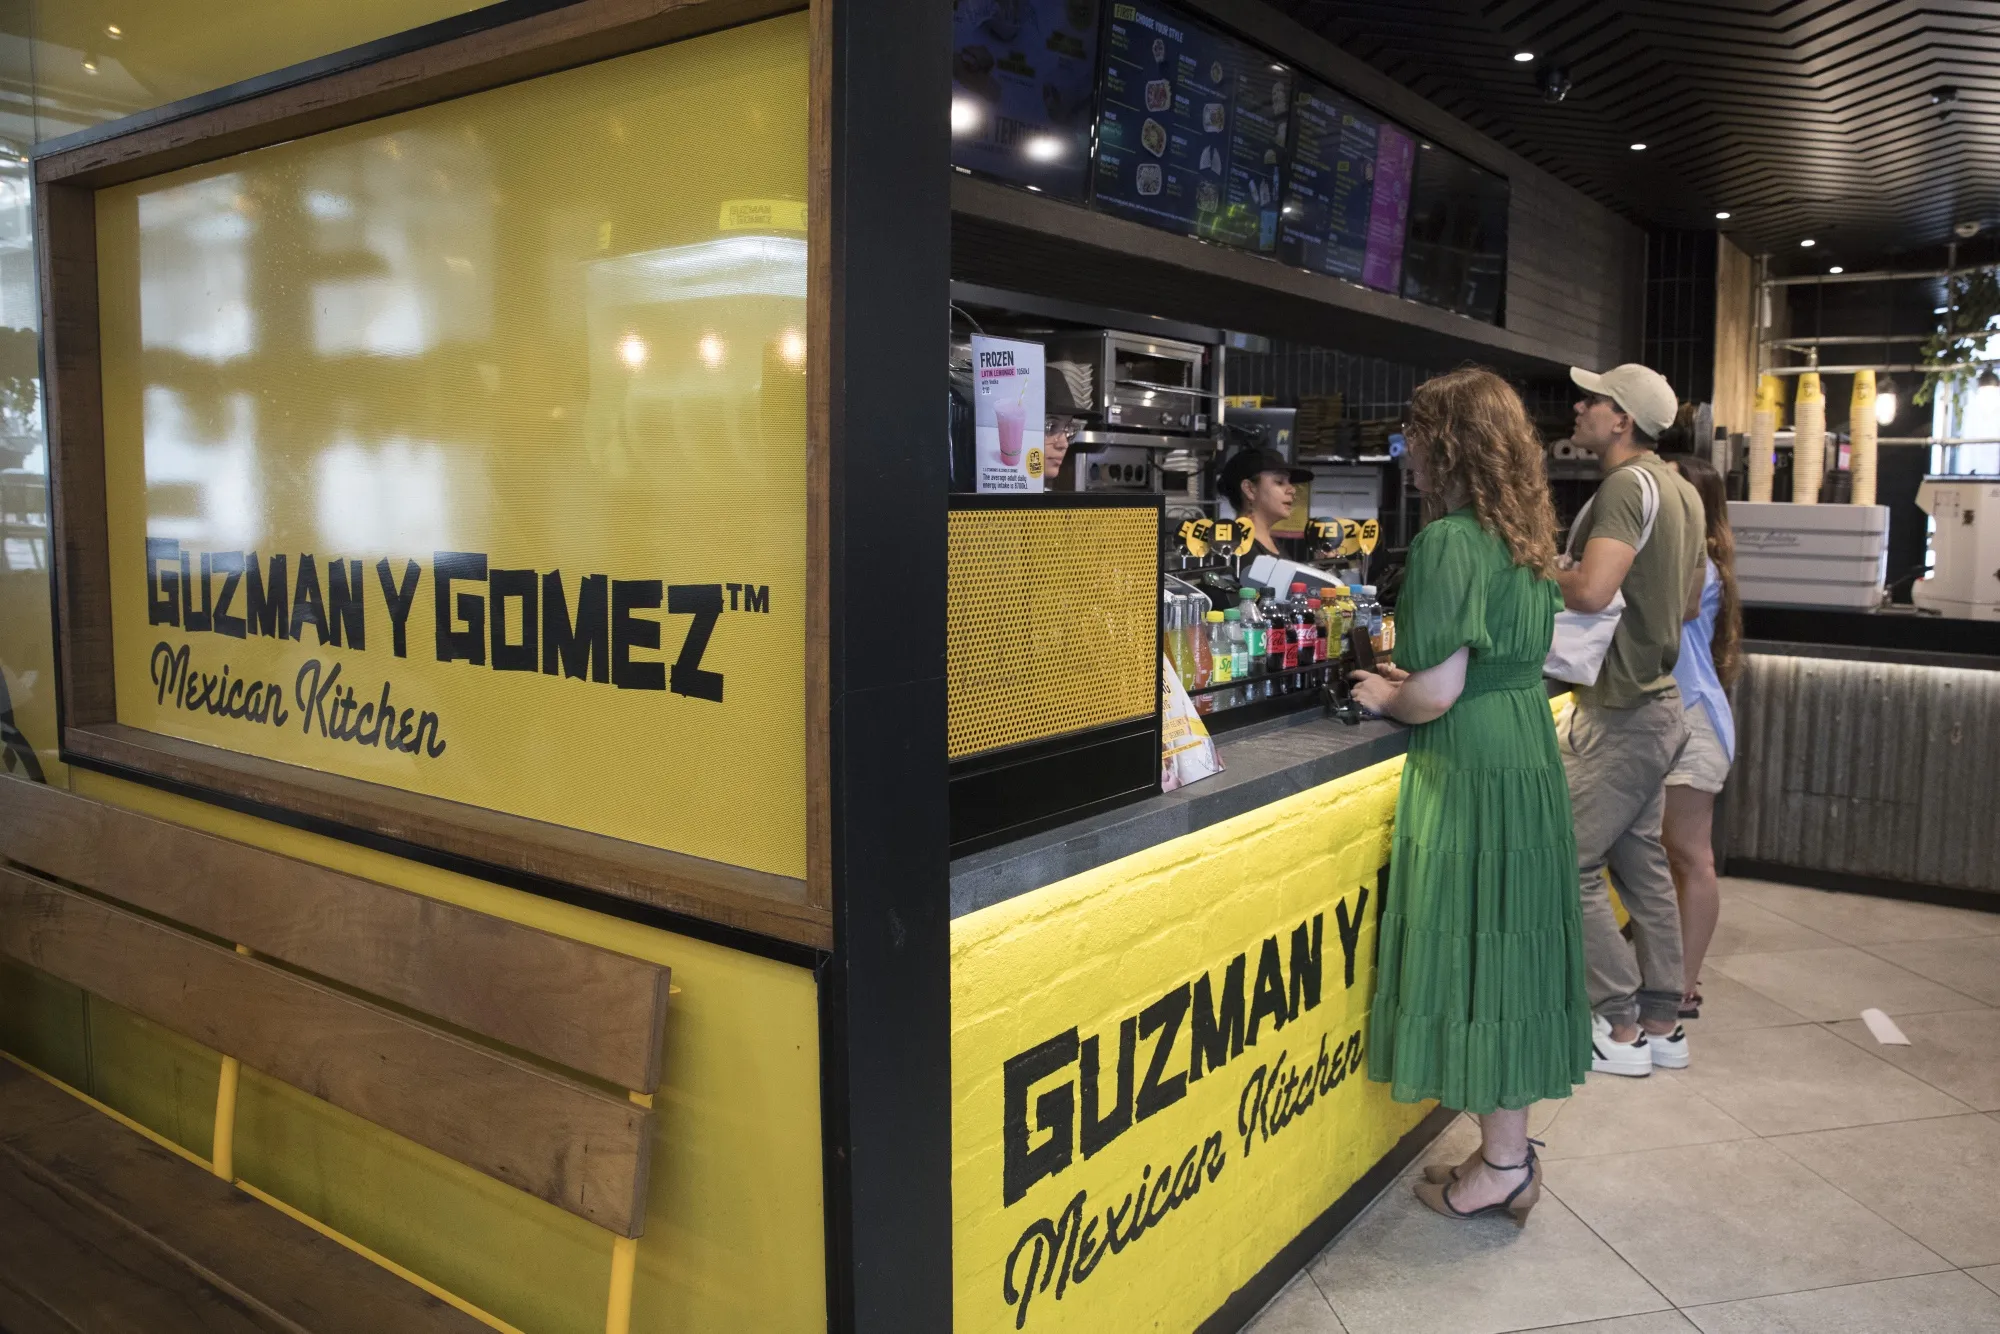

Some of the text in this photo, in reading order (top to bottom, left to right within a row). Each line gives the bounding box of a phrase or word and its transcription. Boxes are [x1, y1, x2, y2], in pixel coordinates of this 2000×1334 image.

[980, 351, 1014, 368] FROZEN
[1215, 523, 1232, 541] 61
[1314, 522, 1338, 538] 73
[1362, 524, 1376, 539] 66
[145, 536, 366, 651] GUZMAN
[376, 554, 422, 659] Y
[433, 550, 725, 704] GOMEZ
[150, 641, 447, 759] Mexican Kitchen
[1003, 913, 1323, 1208] GUZMAN
[1335, 887, 1369, 989] Y
[1003, 1029, 1364, 1330] Mexican Kitchen
